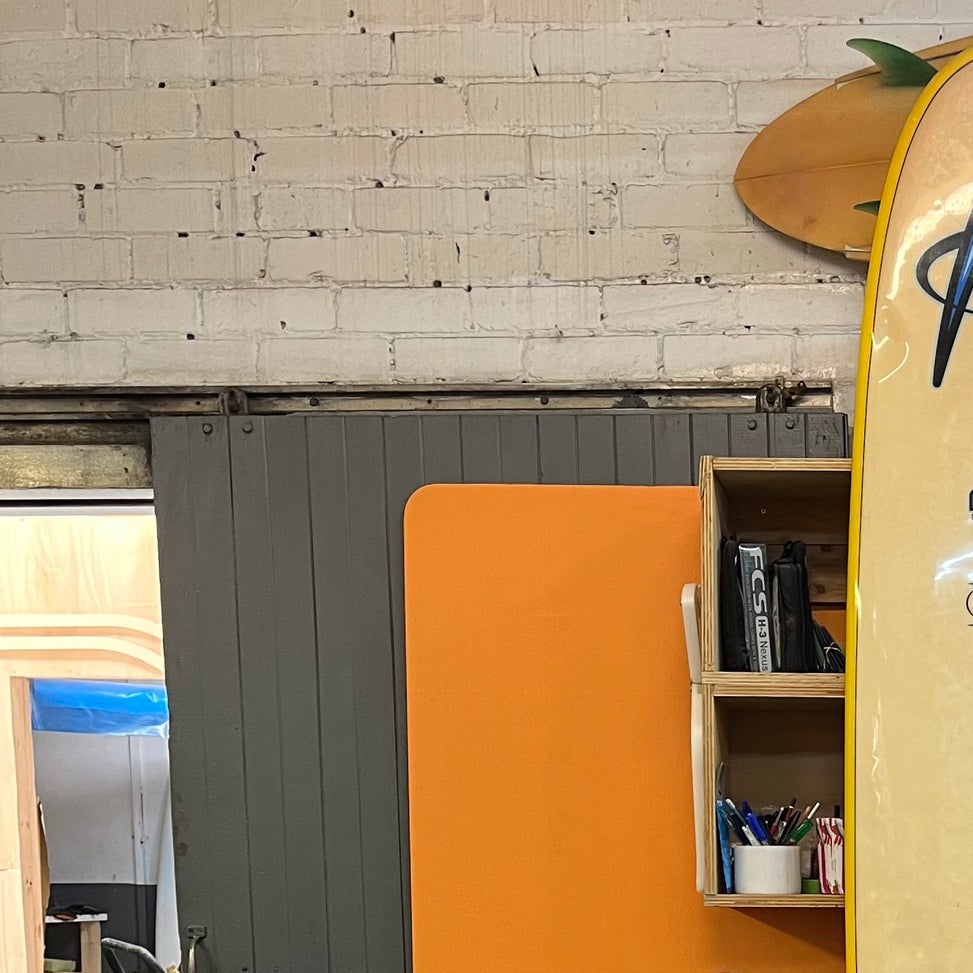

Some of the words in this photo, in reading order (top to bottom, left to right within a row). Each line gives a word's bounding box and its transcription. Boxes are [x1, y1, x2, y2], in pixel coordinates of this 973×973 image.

[749, 548, 768, 613] FCS
[757, 619, 768, 638] H-3
[759, 640, 769, 672] Nexus
